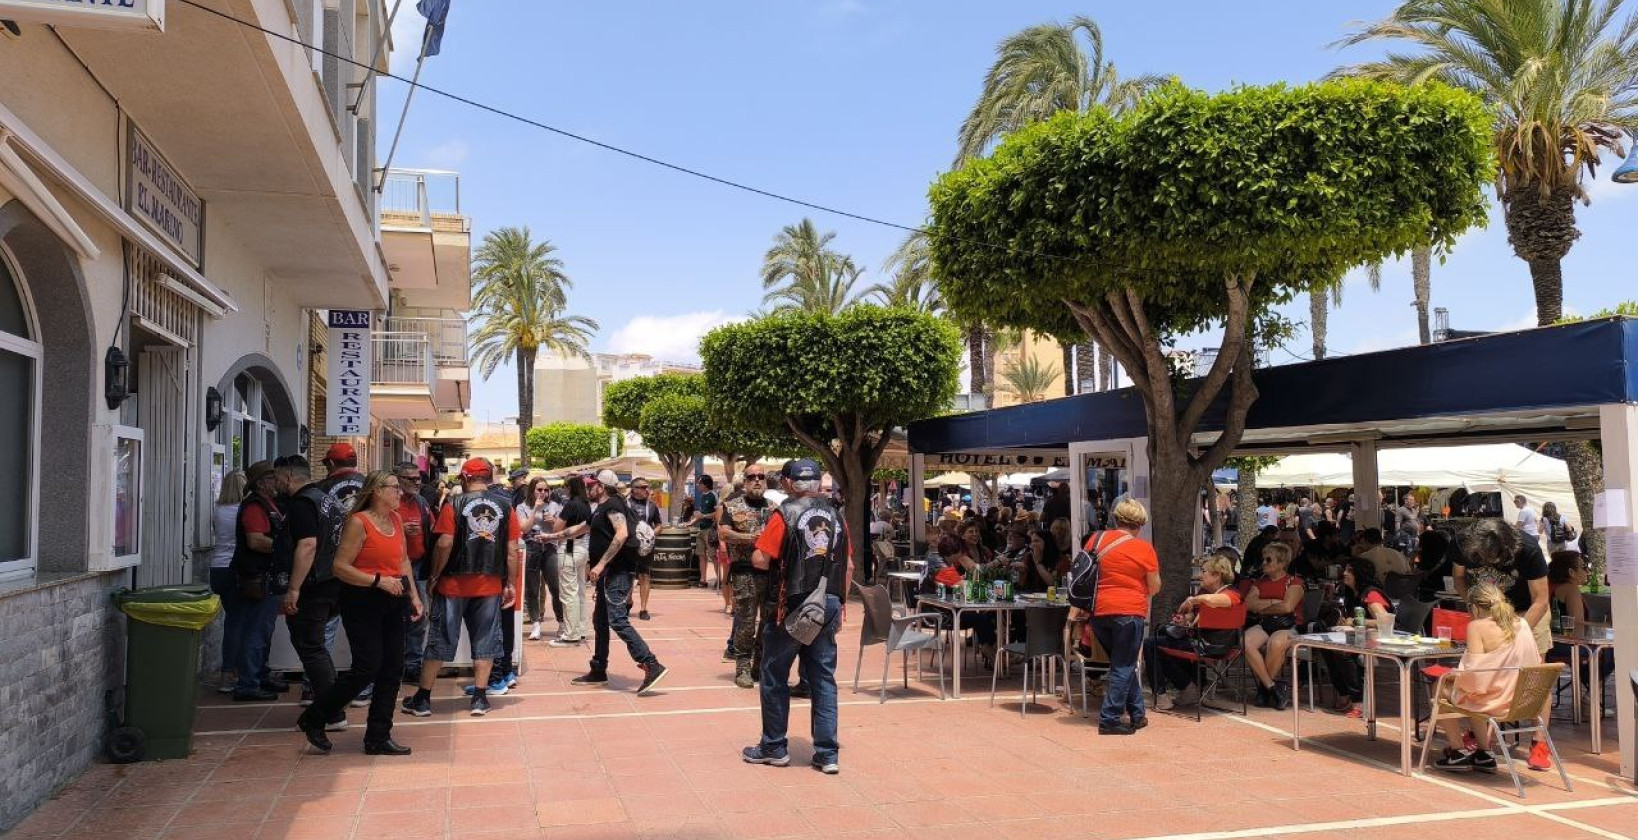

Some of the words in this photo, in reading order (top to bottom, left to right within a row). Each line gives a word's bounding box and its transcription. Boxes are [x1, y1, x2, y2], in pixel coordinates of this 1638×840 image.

[137, 181, 150, 216] EL
[332, 311, 369, 325] BAR
[339, 332, 361, 434] RESTAURANTE
[940, 453, 1011, 466] HOTEL
